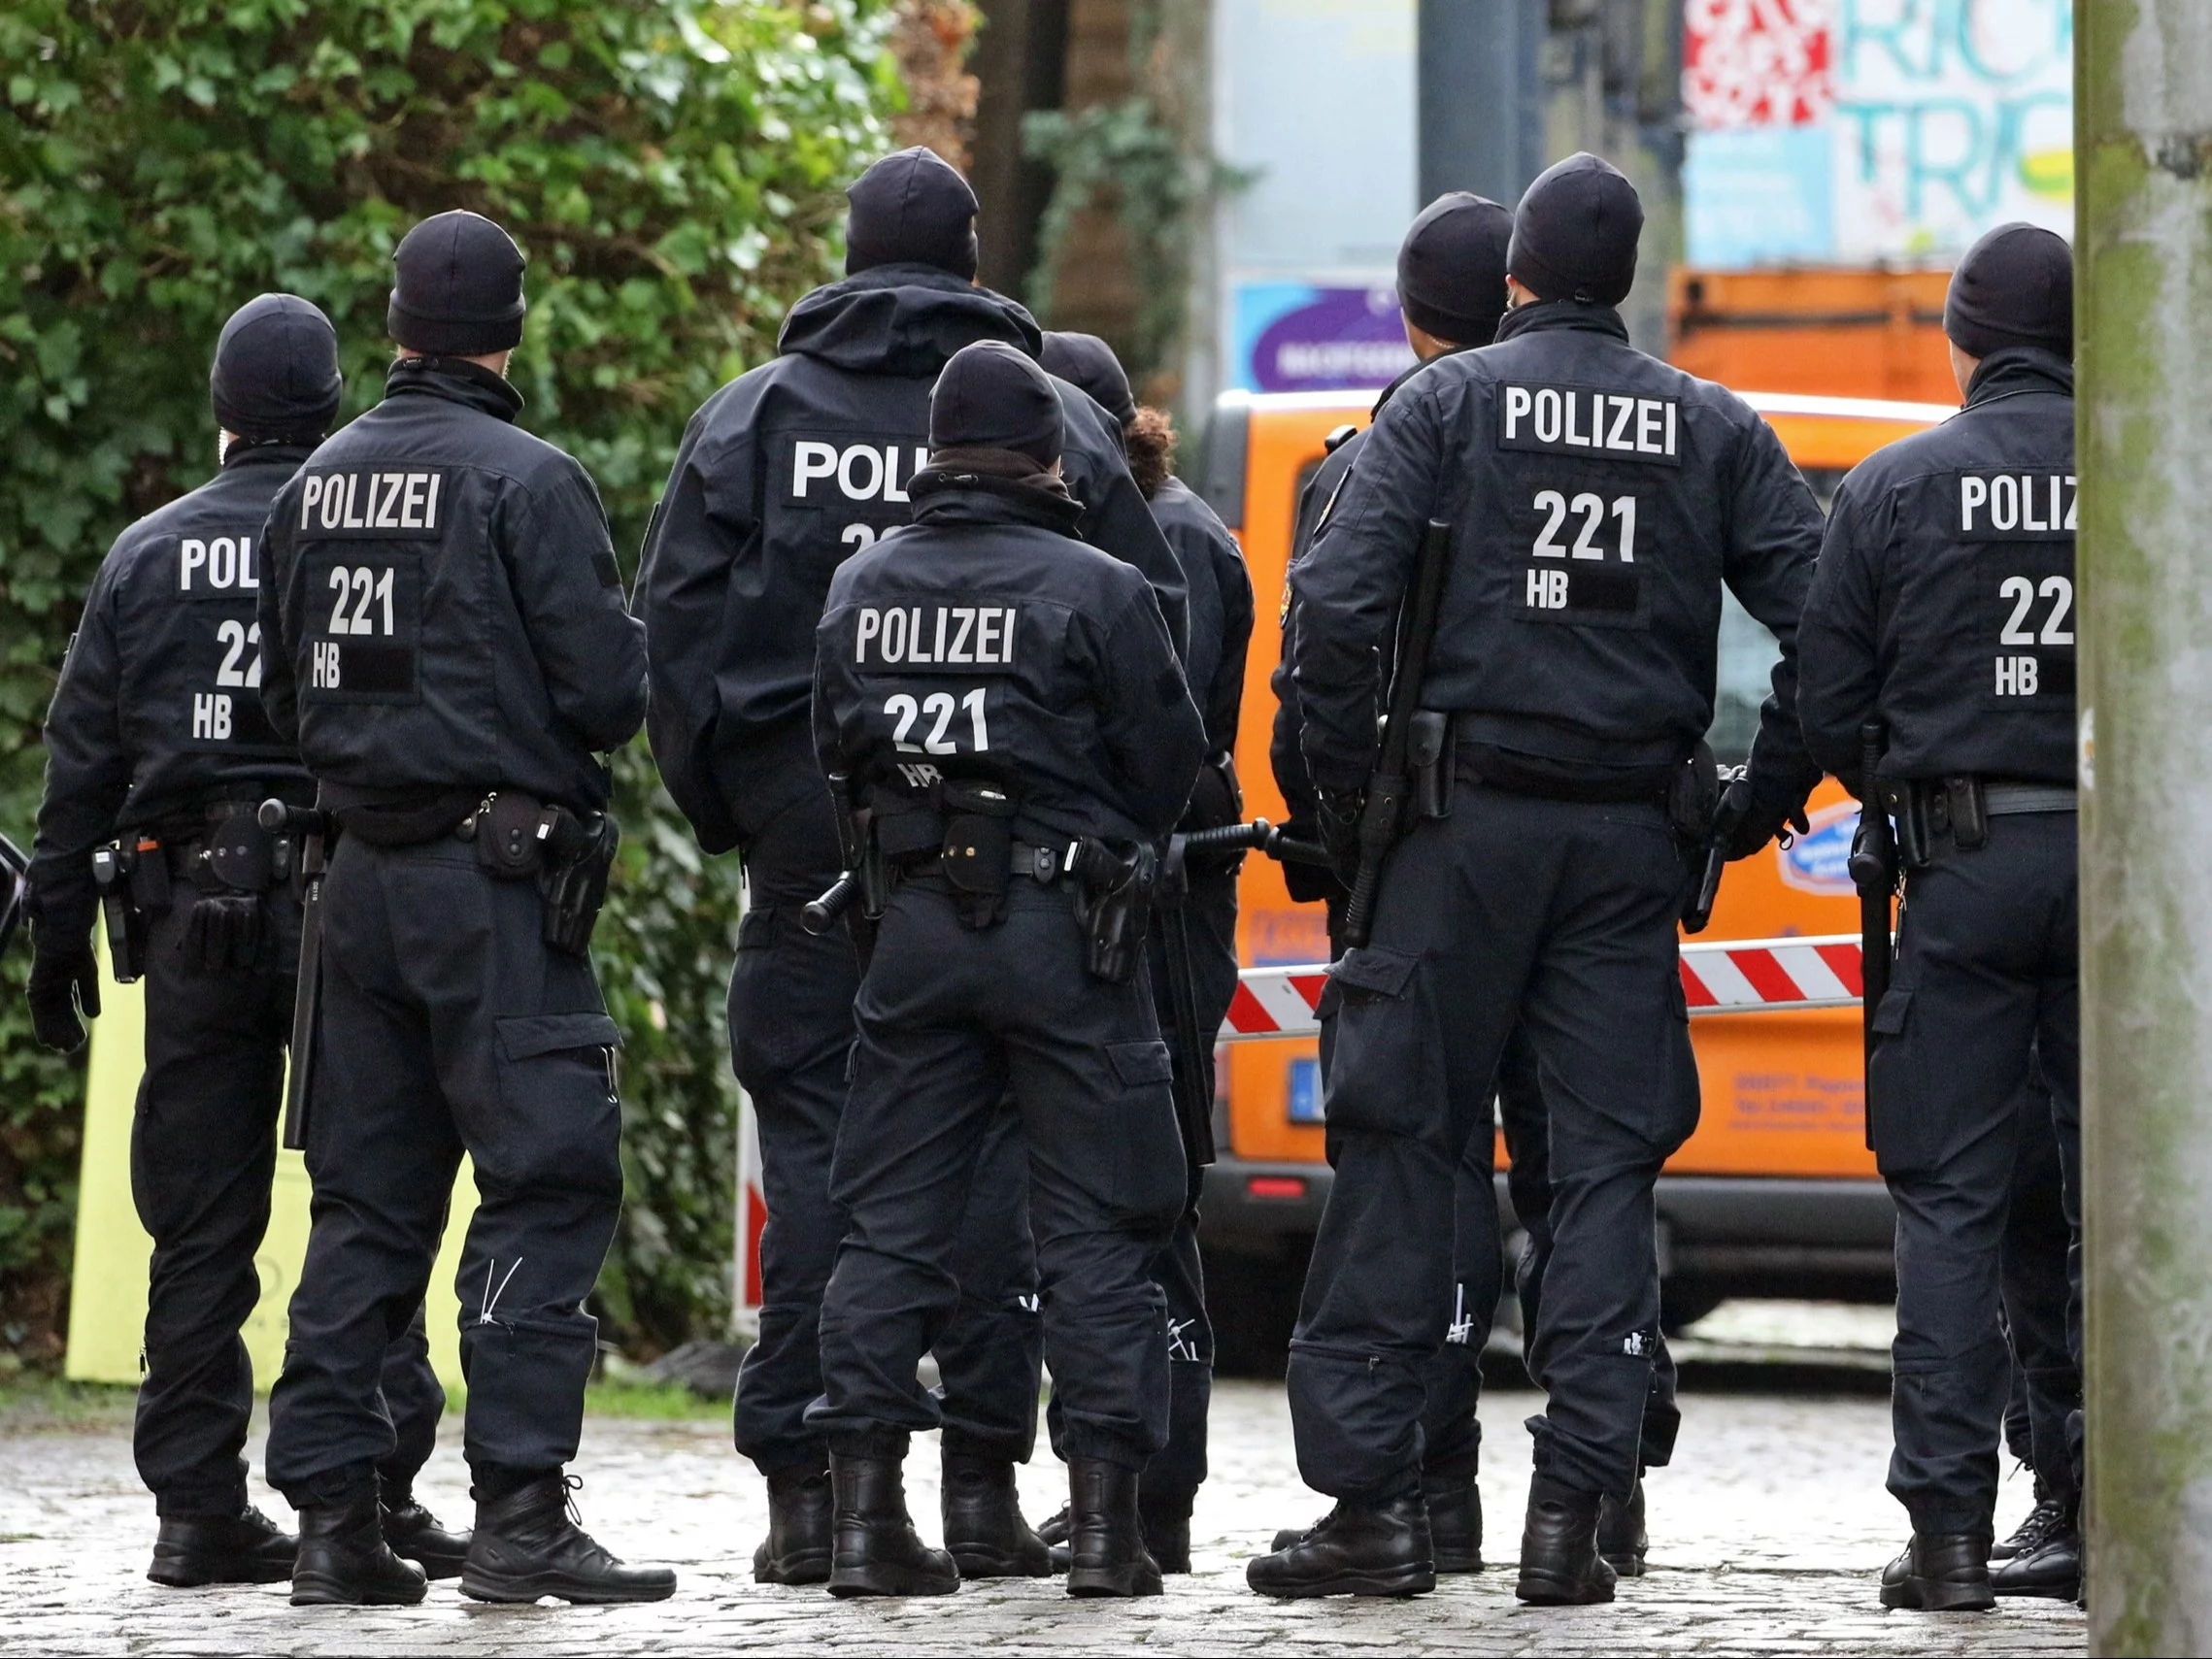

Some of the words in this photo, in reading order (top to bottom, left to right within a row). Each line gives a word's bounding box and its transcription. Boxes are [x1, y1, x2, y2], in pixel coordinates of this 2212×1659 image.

[1505, 386, 1677, 456] POLIZEI
[300, 473, 441, 530] POLIZEI
[1531, 489, 1637, 563] 221
[181, 536, 260, 591] POL
[1525, 569, 1569, 610] HB
[328, 565, 395, 636] 221
[1998, 575, 2075, 646] 22
[855, 607, 1017, 663] POLIZEI
[312, 641, 341, 689] HB
[1994, 656, 2038, 696] HB
[192, 692, 233, 741] HB
[883, 687, 989, 755] 221
